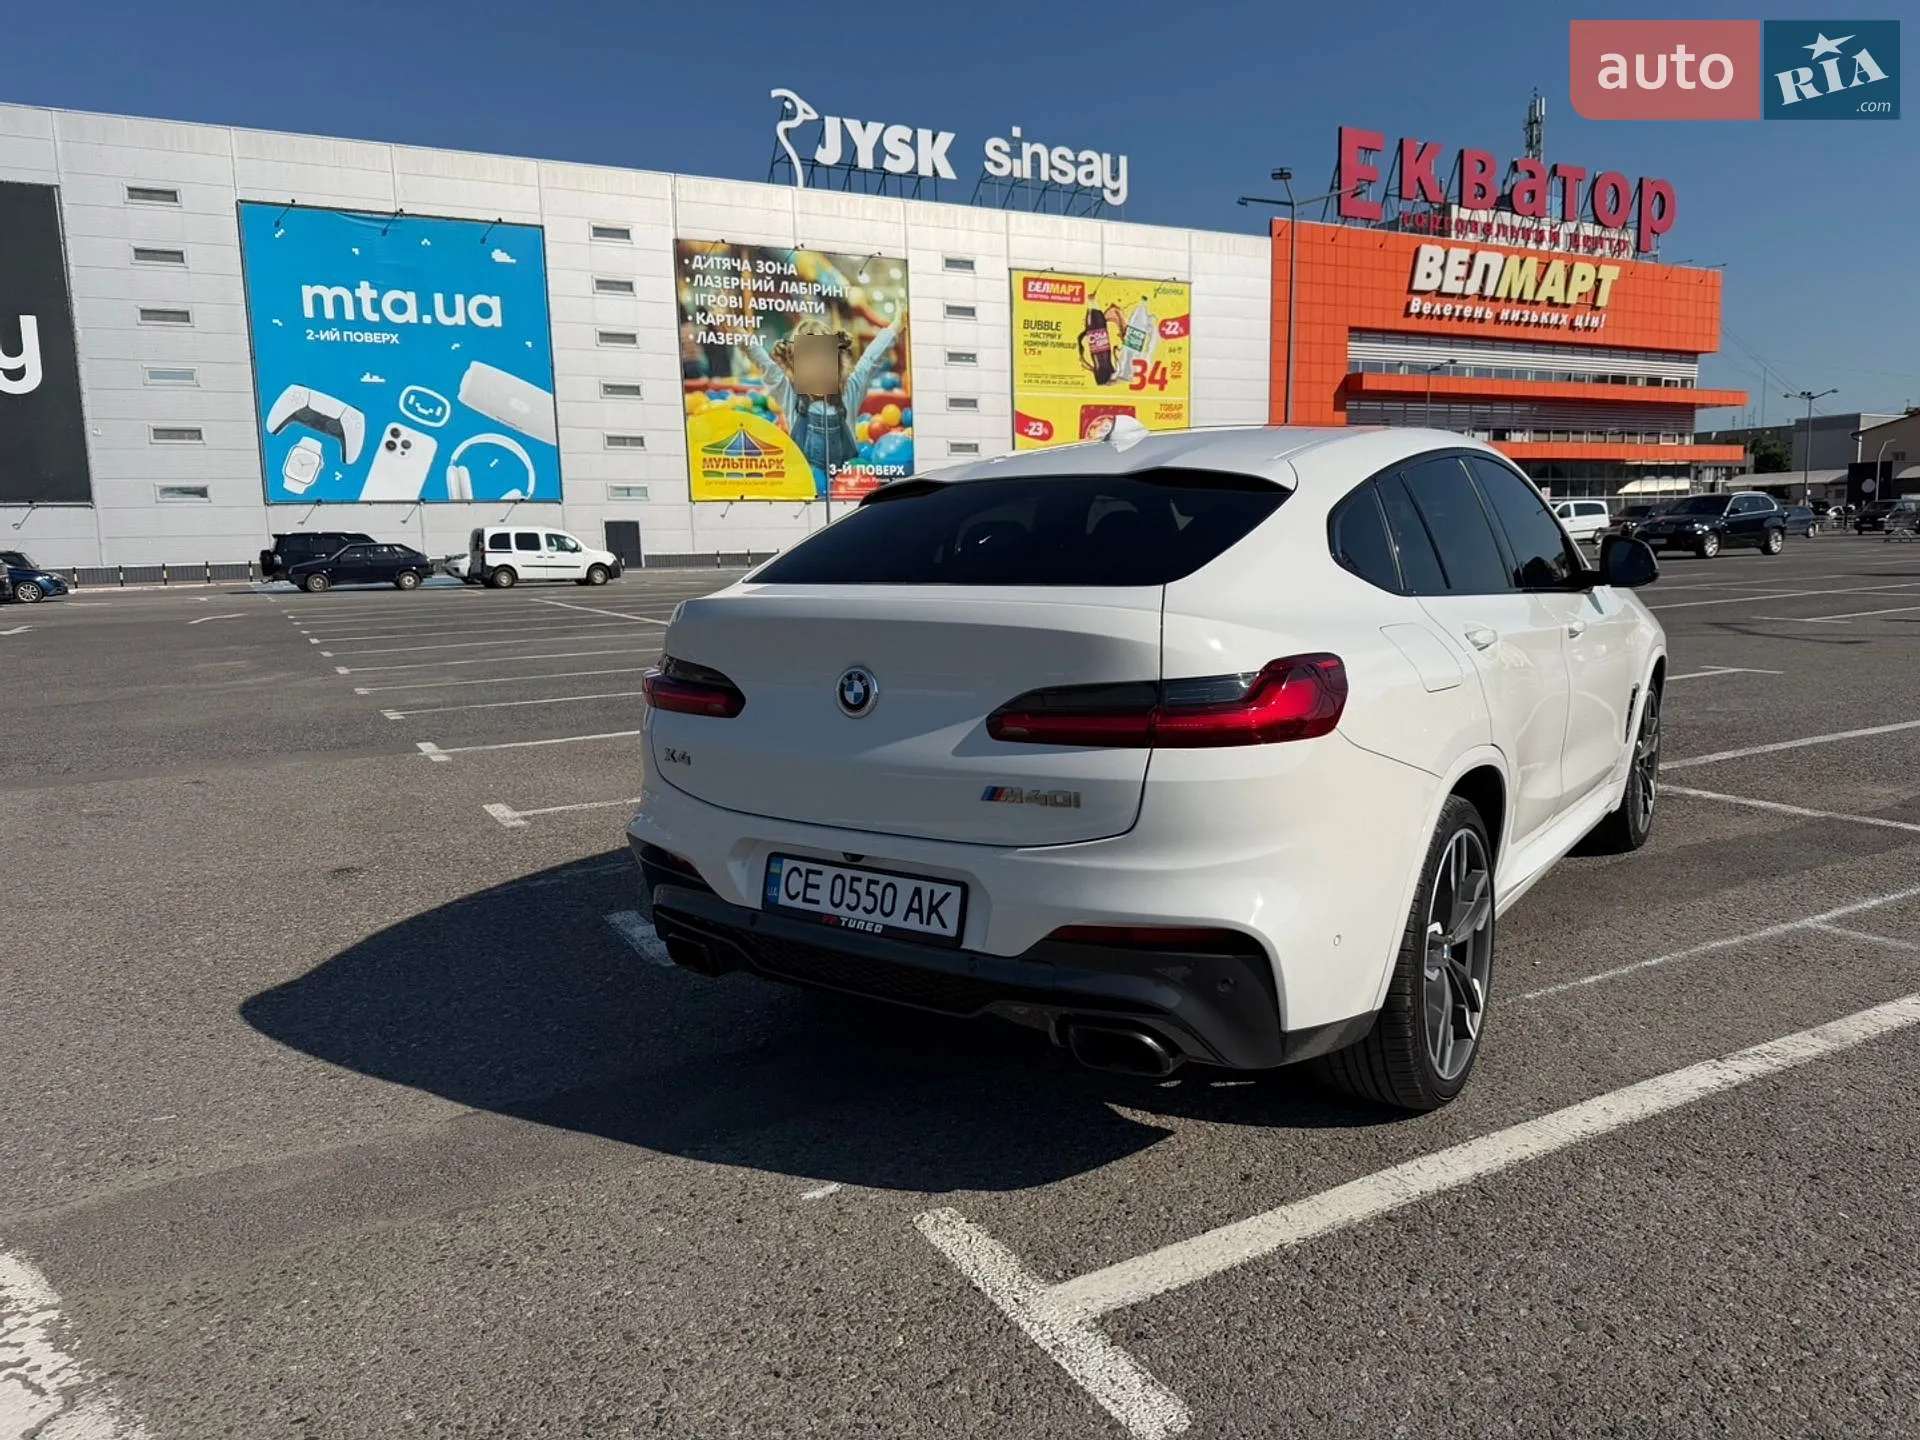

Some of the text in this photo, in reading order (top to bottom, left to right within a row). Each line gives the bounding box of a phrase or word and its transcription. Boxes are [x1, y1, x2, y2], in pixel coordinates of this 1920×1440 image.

[815, 116, 957, 180] JYSK
[984, 126, 1128, 206] sinsay
[691, 255, 798, 276] ДИТЯЧА ЗОНА
[1410, 243, 1621, 307] ВЕЛМАРТ
[693, 275, 850, 298] ЛАЗЕРНИЙ ЛАБІРИНТ
[301, 281, 503, 327] mta.ua
[695, 293, 826, 314] ІГРОВІ АВТОМАТИ
[1408, 297, 1607, 331] Велетень низьких цін!
[695, 312, 764, 328] КАРТИНГ
[1023, 319, 1062, 331] BUBBLE
[306, 328, 400, 344] 2-ИЙ ПОВЕРХ
[696, 331, 767, 346] ЛАЗЕРТАГ
[1129, 359, 1168, 391] 34
[702, 457, 785, 469] МУЛЬТІПАРК
[829, 461, 905, 476] 3-Й ПОВЕРХ
[664, 747, 691, 766] X4
[784, 866, 952, 929] CE 0550 AK
